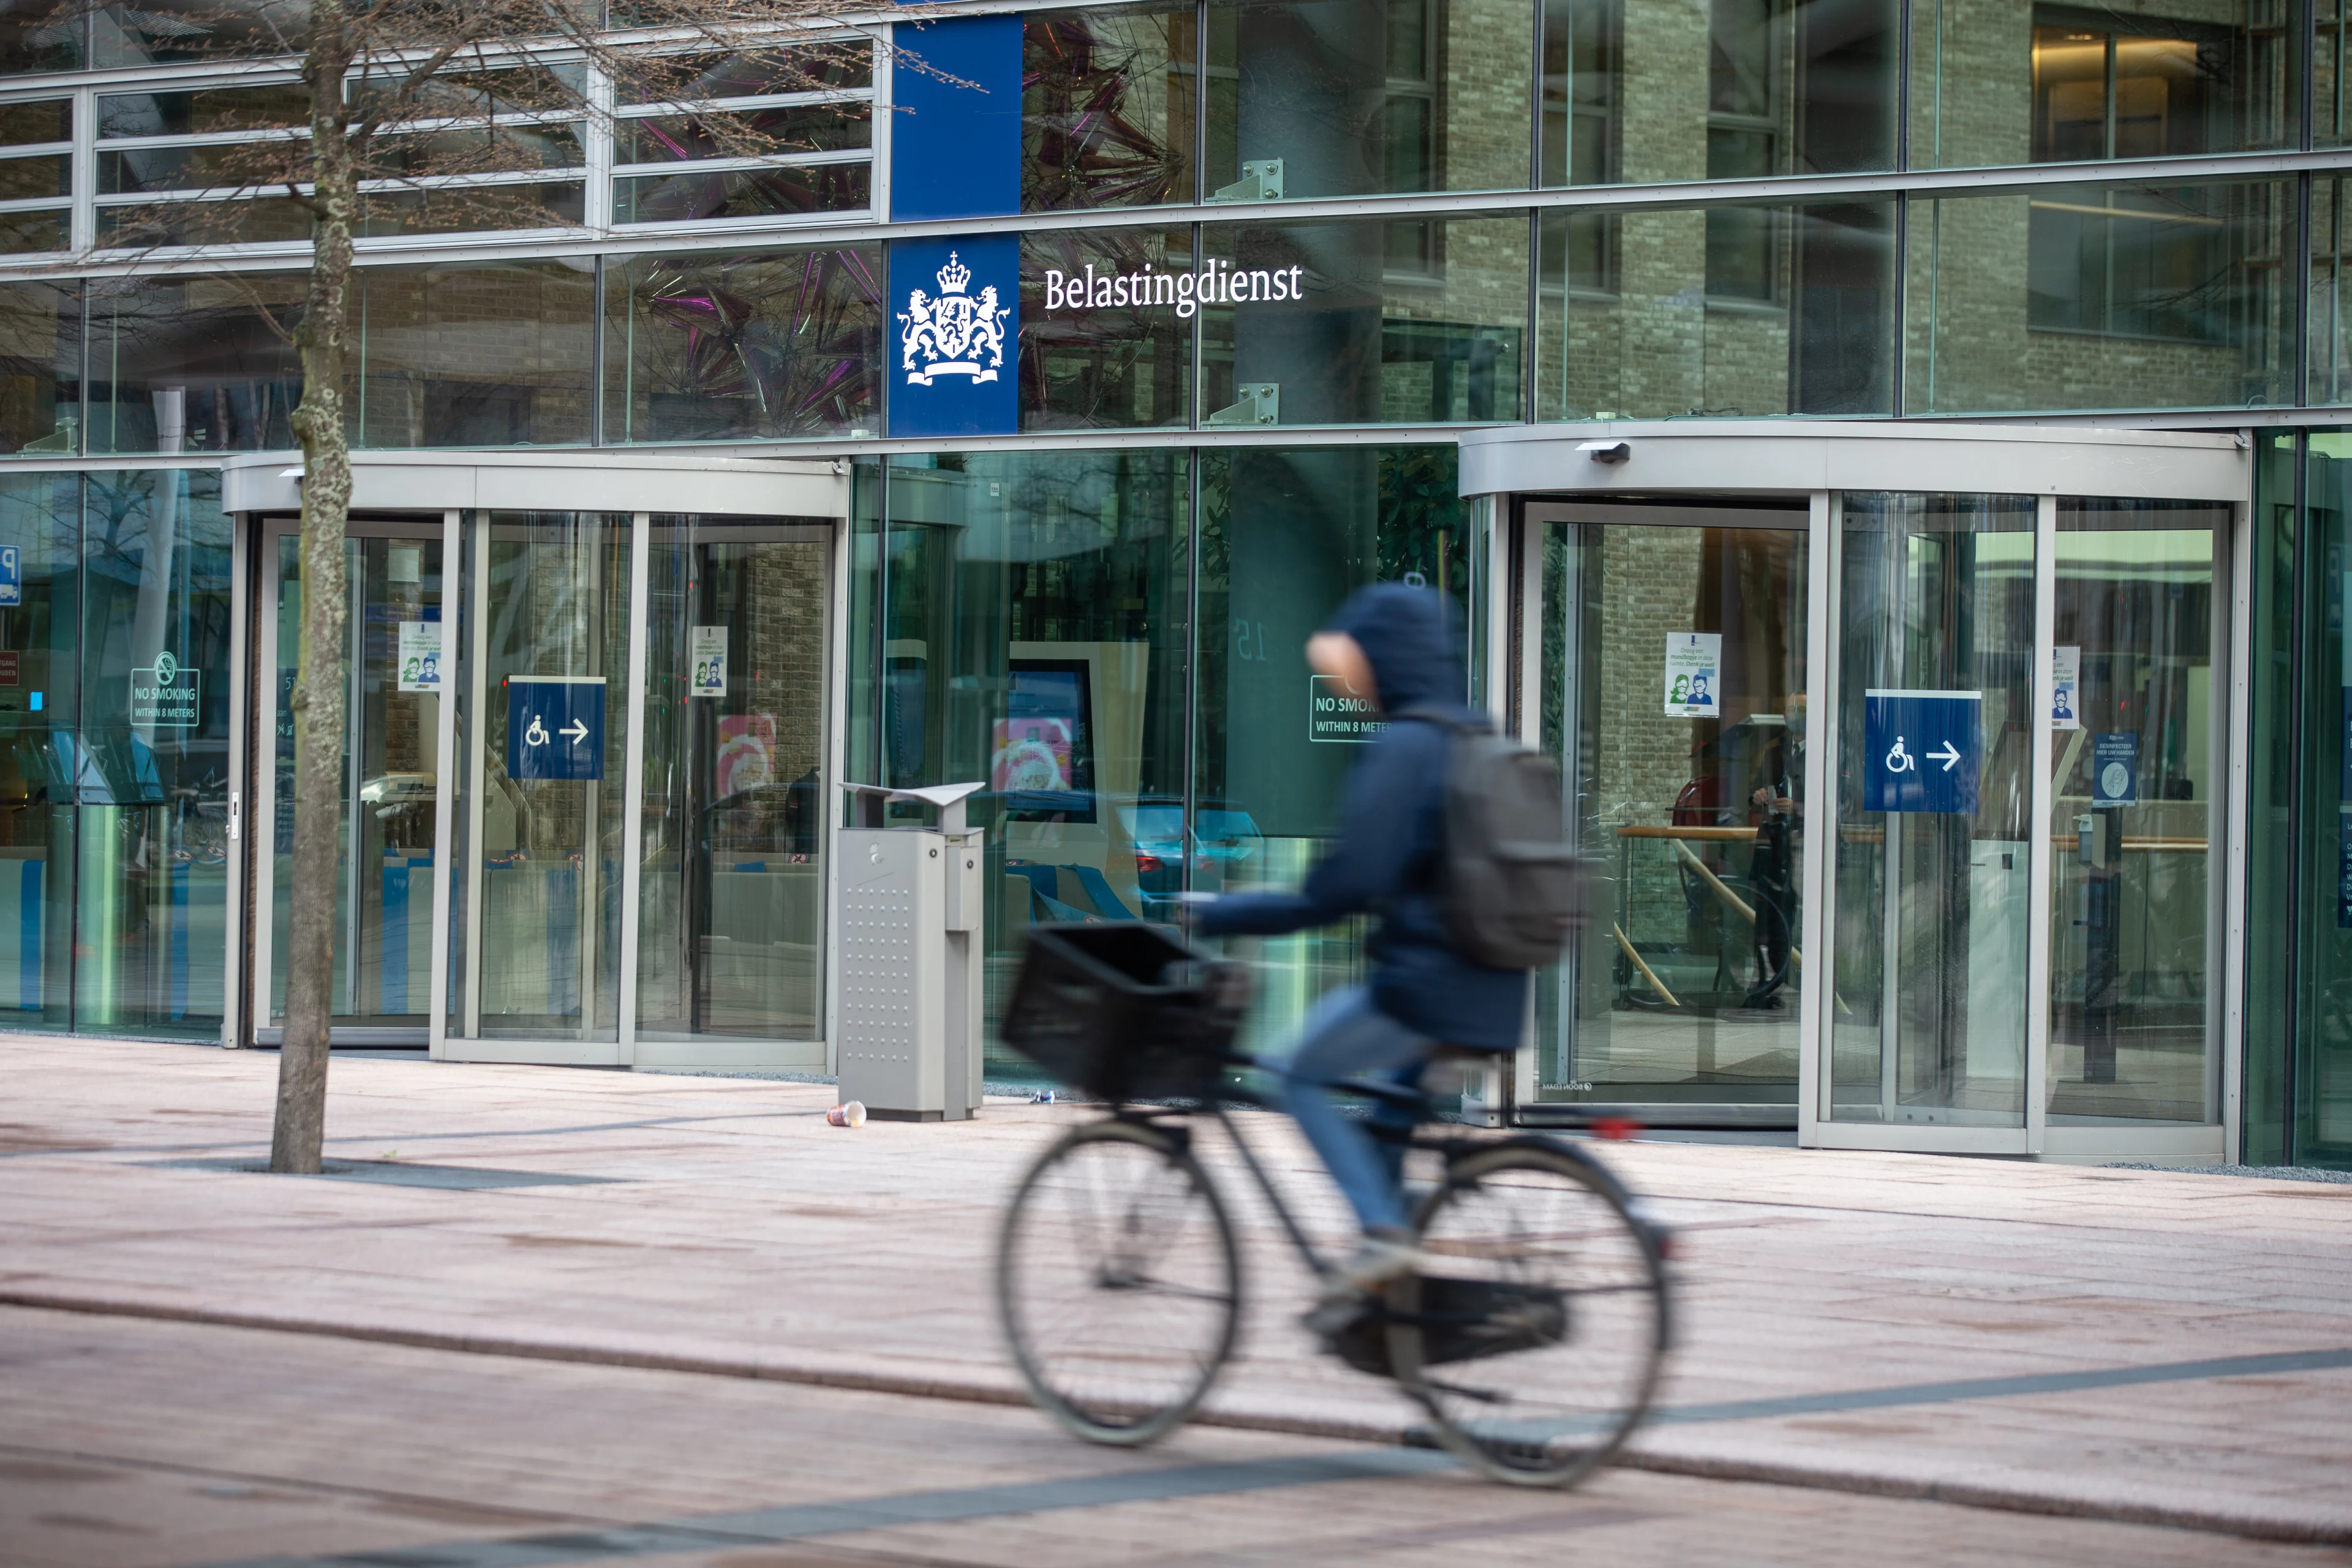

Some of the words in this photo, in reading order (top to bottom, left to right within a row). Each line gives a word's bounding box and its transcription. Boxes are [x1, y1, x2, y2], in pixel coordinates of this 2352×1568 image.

[1045, 258, 1303, 318] Belastingdienst
[135, 688, 149, 699] NO
[151, 688, 195, 701] SMOKING
[1316, 698, 1335, 711] NO
[1338, 698, 1379, 712] SMOK
[135, 707, 160, 717] WITHIN
[162, 708, 166, 717] 8
[167, 708, 195, 718] METERS
[1316, 722, 1351, 732] WITHIN
[1353, 722, 1359, 732] 8
[1361, 722, 1393, 733] METER
